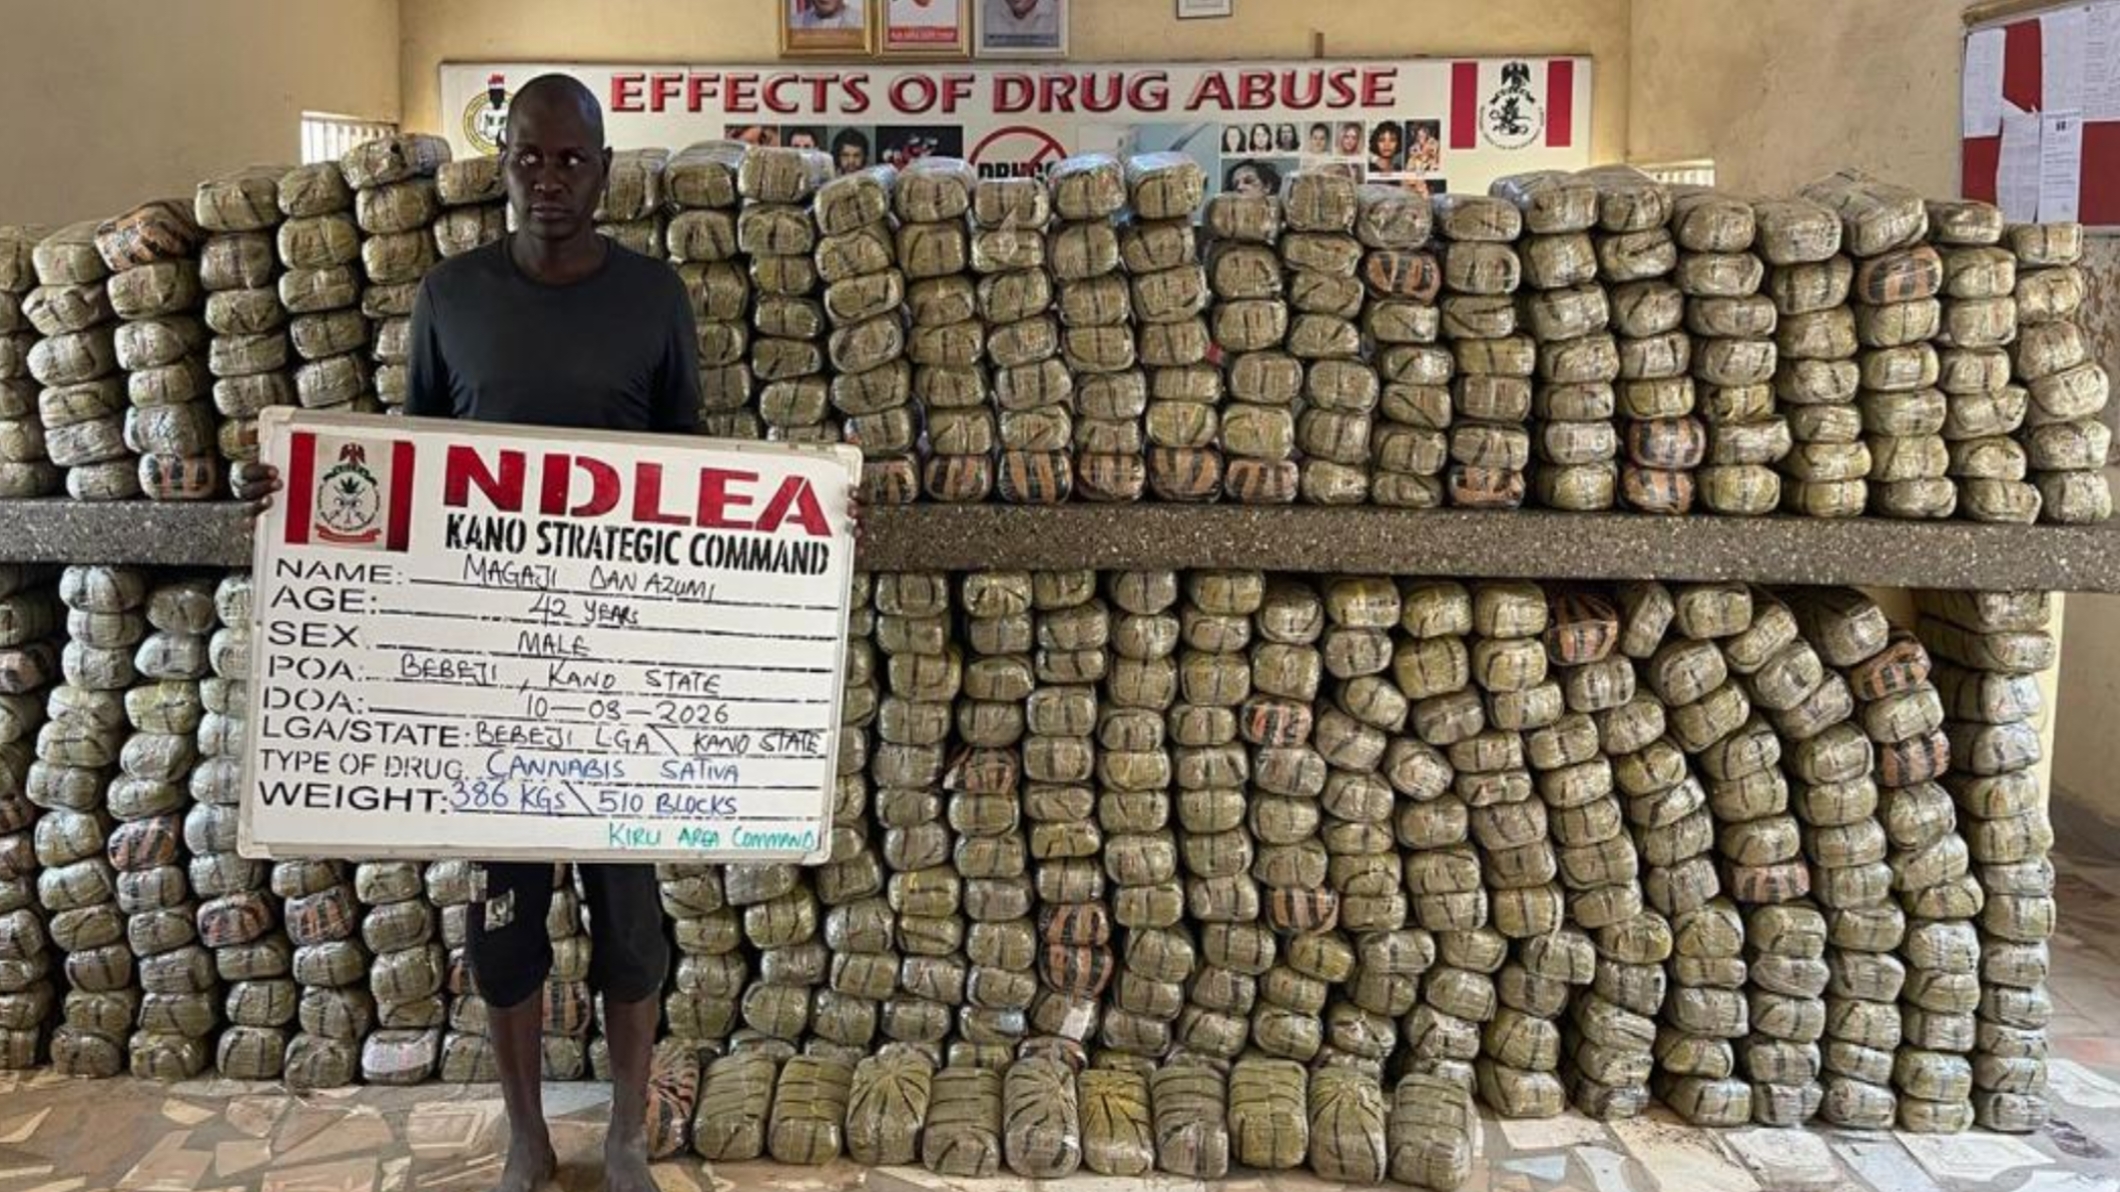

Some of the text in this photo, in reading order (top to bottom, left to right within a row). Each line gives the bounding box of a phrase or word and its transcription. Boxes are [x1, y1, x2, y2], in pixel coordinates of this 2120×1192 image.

[611, 67, 1399, 114] EFFECTS OF DRUG ABUSE
[443, 443, 833, 538] NDLEA
[445, 514, 830, 577] KANO STRATEGIC COMMAND
[276, 558, 402, 585] NAME:
[463, 553, 557, 591] MAGAJI
[271, 585, 377, 615] AGE:
[528, 593, 572, 627] 42
[517, 630, 590, 657] MALE
[402, 653, 497, 686] BEBEJI
[549, 657, 616, 690] KANO
[645, 668, 722, 695] STATE
[263, 686, 364, 715] DOA:
[262, 715, 471, 748] LGA/STATE:
[476, 721, 573, 750] BEBEJI
[694, 731, 750, 757] KANO
[759, 730, 822, 754] STATE
[260, 748, 330, 773] TYPE
[339, 752, 377, 776] OF
[486, 751, 740, 784] CANNABIS SATIVA
[259, 780, 448, 815] WEIGHT:
[450, 776, 509, 808] 386
[597, 790, 644, 813] 510
[656, 791, 738, 816] BLOCKS
[608, 822, 661, 847] KIRU
